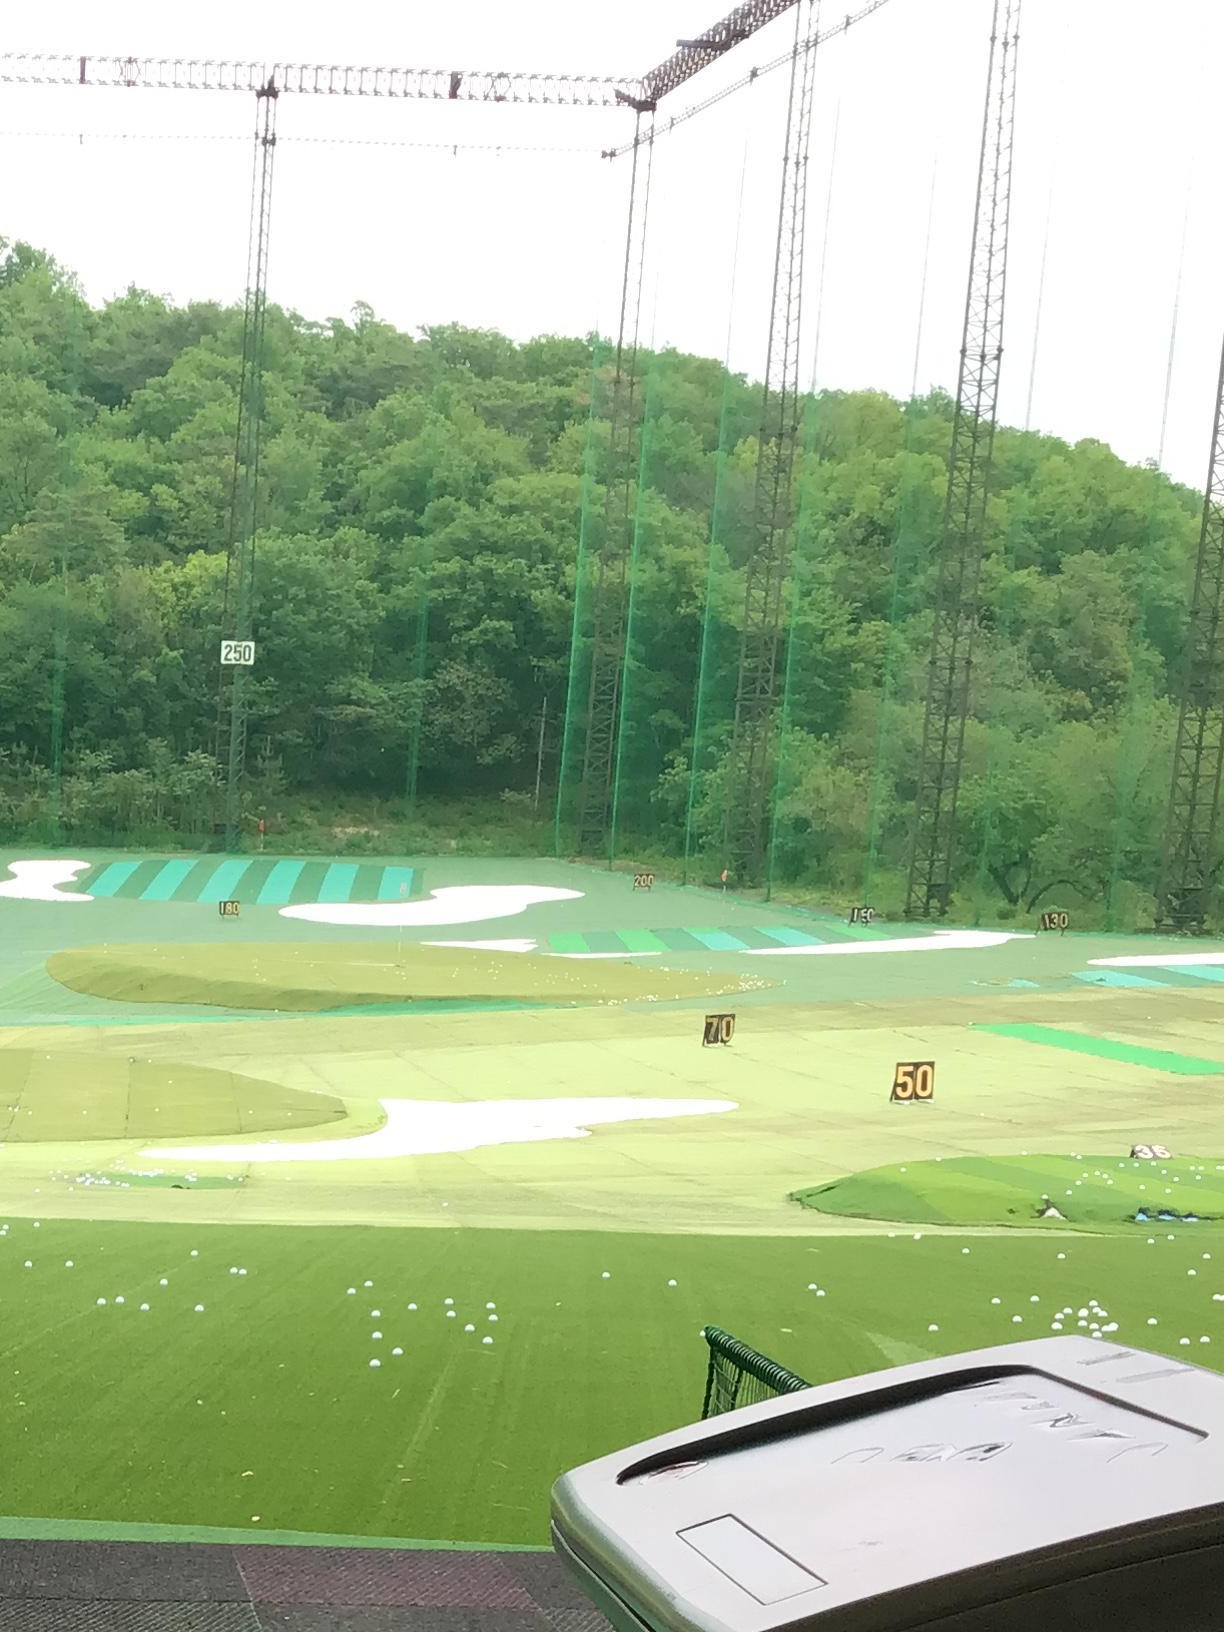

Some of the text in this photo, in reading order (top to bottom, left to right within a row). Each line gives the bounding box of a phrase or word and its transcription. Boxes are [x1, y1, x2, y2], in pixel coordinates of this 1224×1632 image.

[224, 644, 252, 662] 250
[634, 874, 654, 887] 200
[220, 901, 239, 914] 180
[1042, 913, 1069, 928] 130
[705, 1015, 735, 1043] 70
[895, 1065, 933, 1099] 50
[1134, 1144, 1172, 1159] 35
